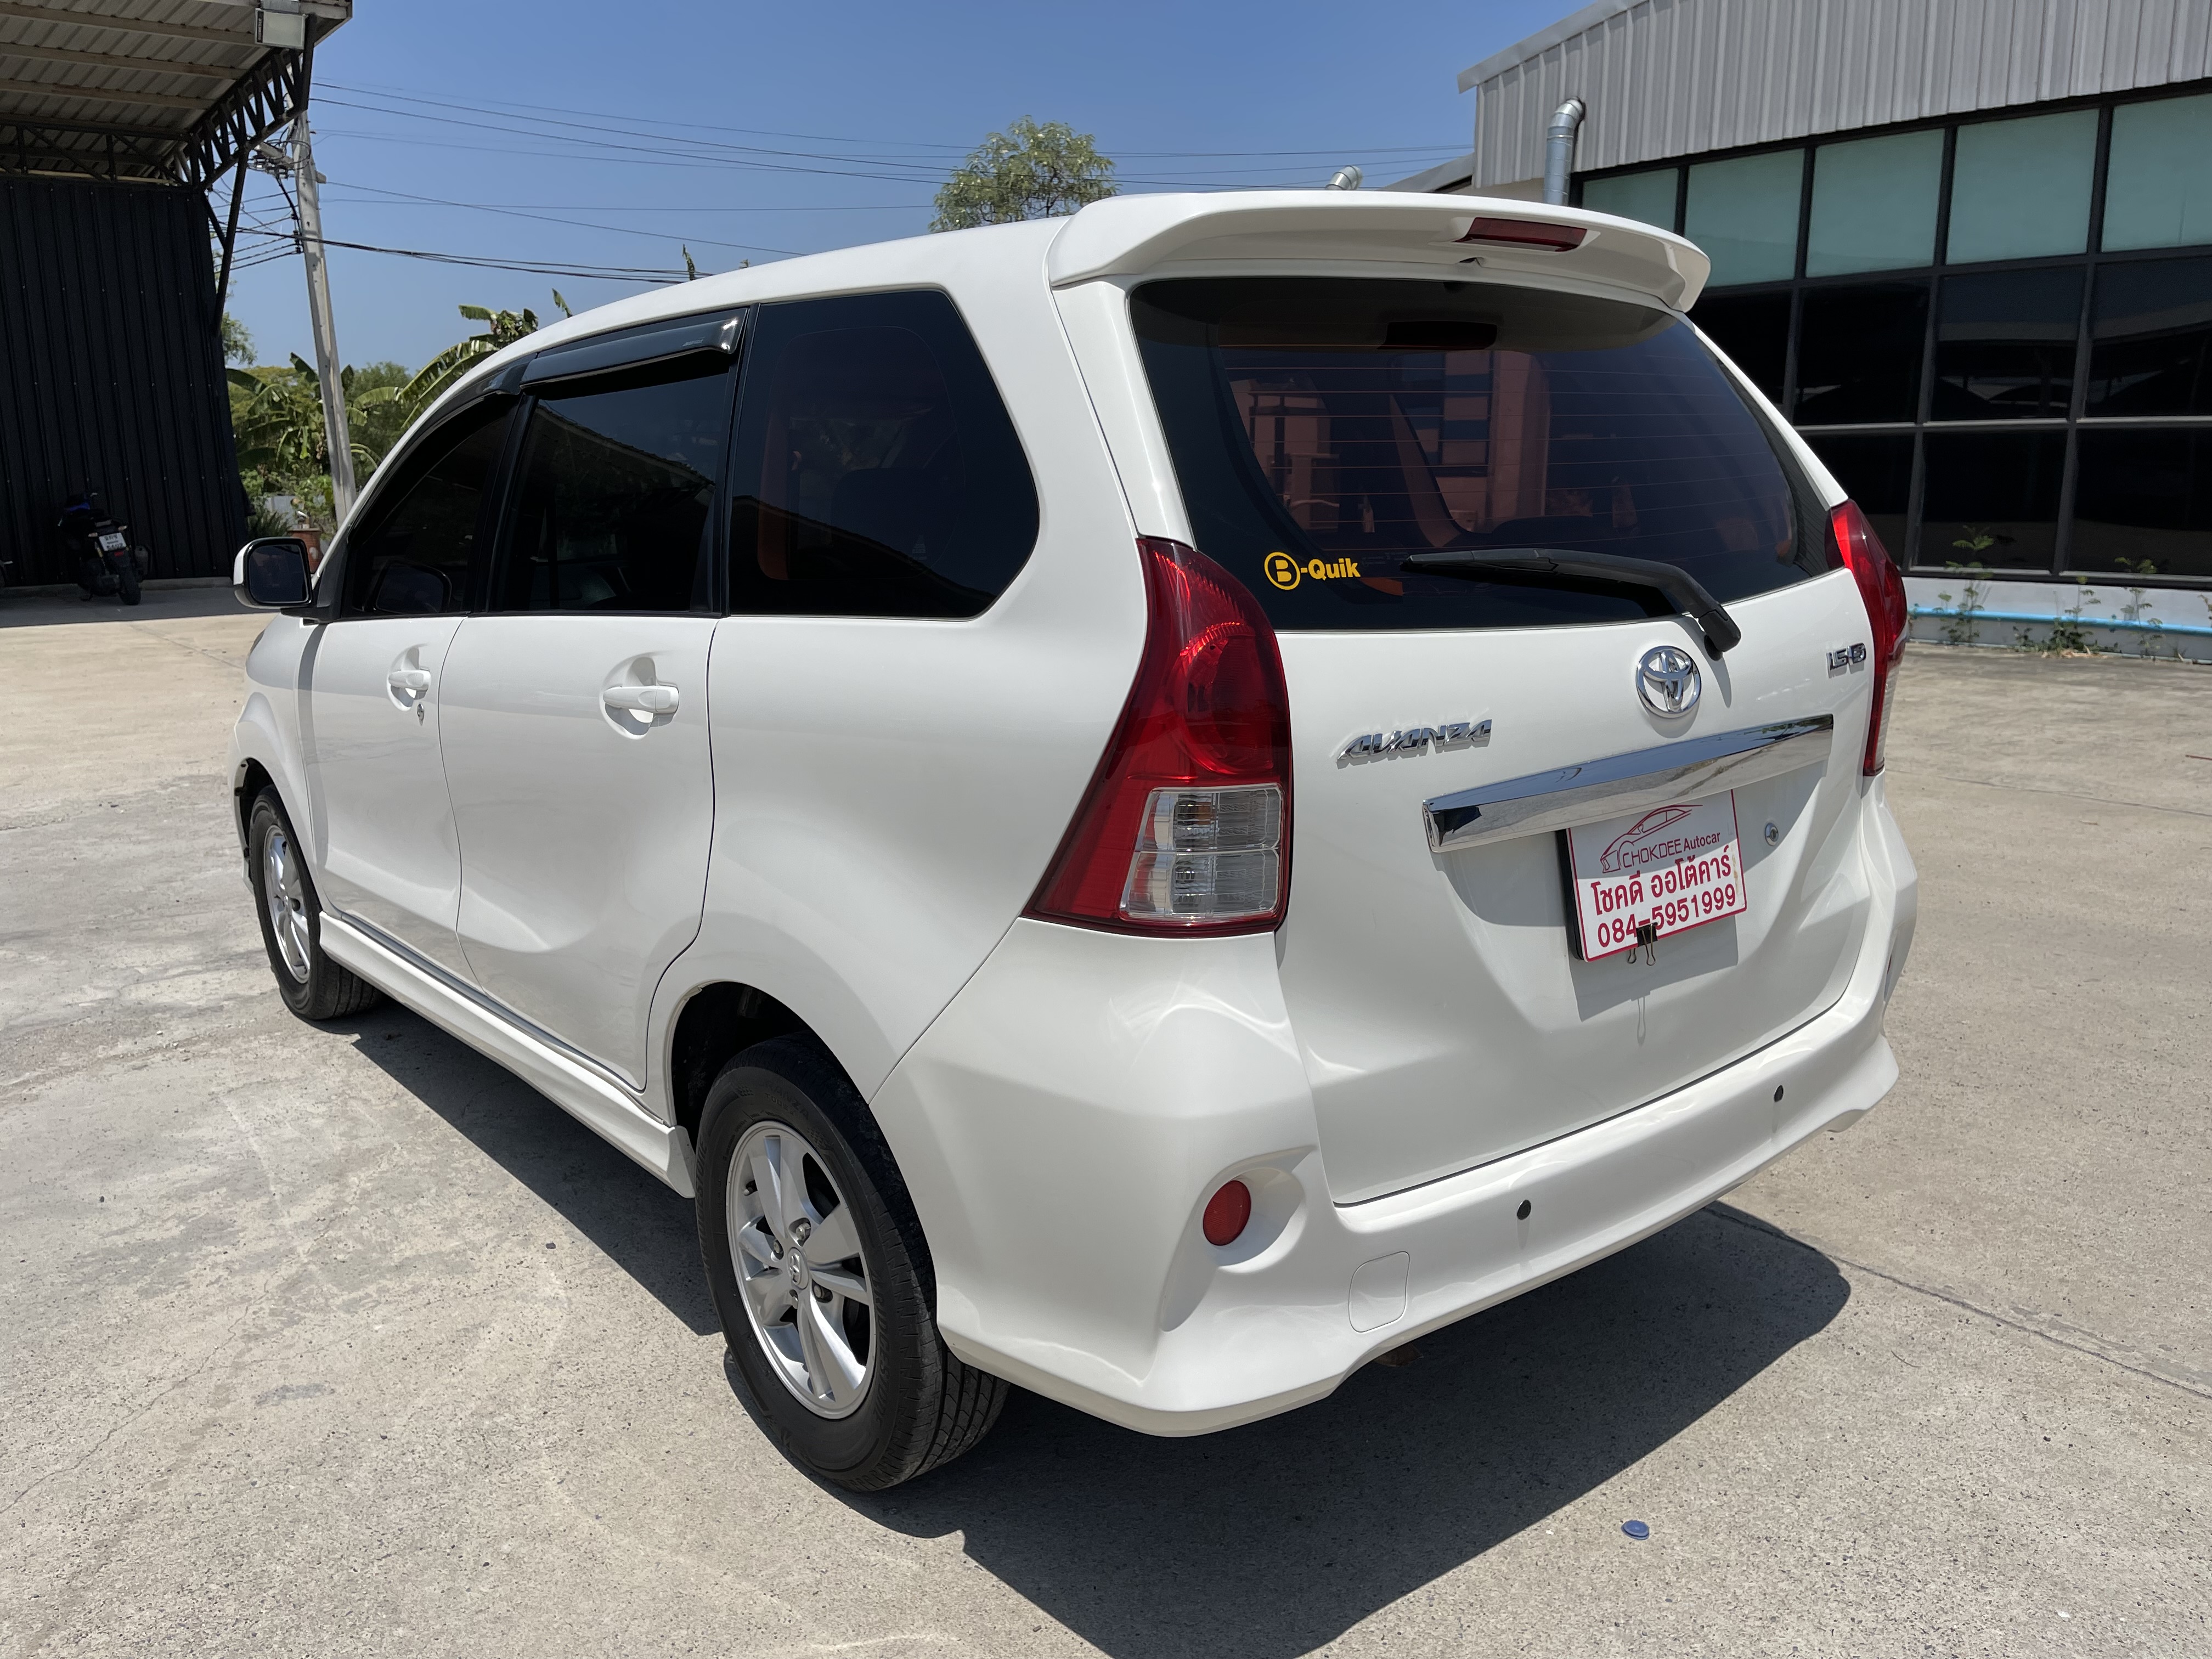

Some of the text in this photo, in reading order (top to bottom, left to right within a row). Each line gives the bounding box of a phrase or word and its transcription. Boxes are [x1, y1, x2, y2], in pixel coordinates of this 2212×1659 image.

[1337, 719, 1492, 760] AVANZA
[1622, 832, 1721, 868] CHOKDEE Autocar
[1590, 845, 1731, 916] โชคดี ออโต้คาร์
[1597, 883, 1736, 947] 084-5951999
